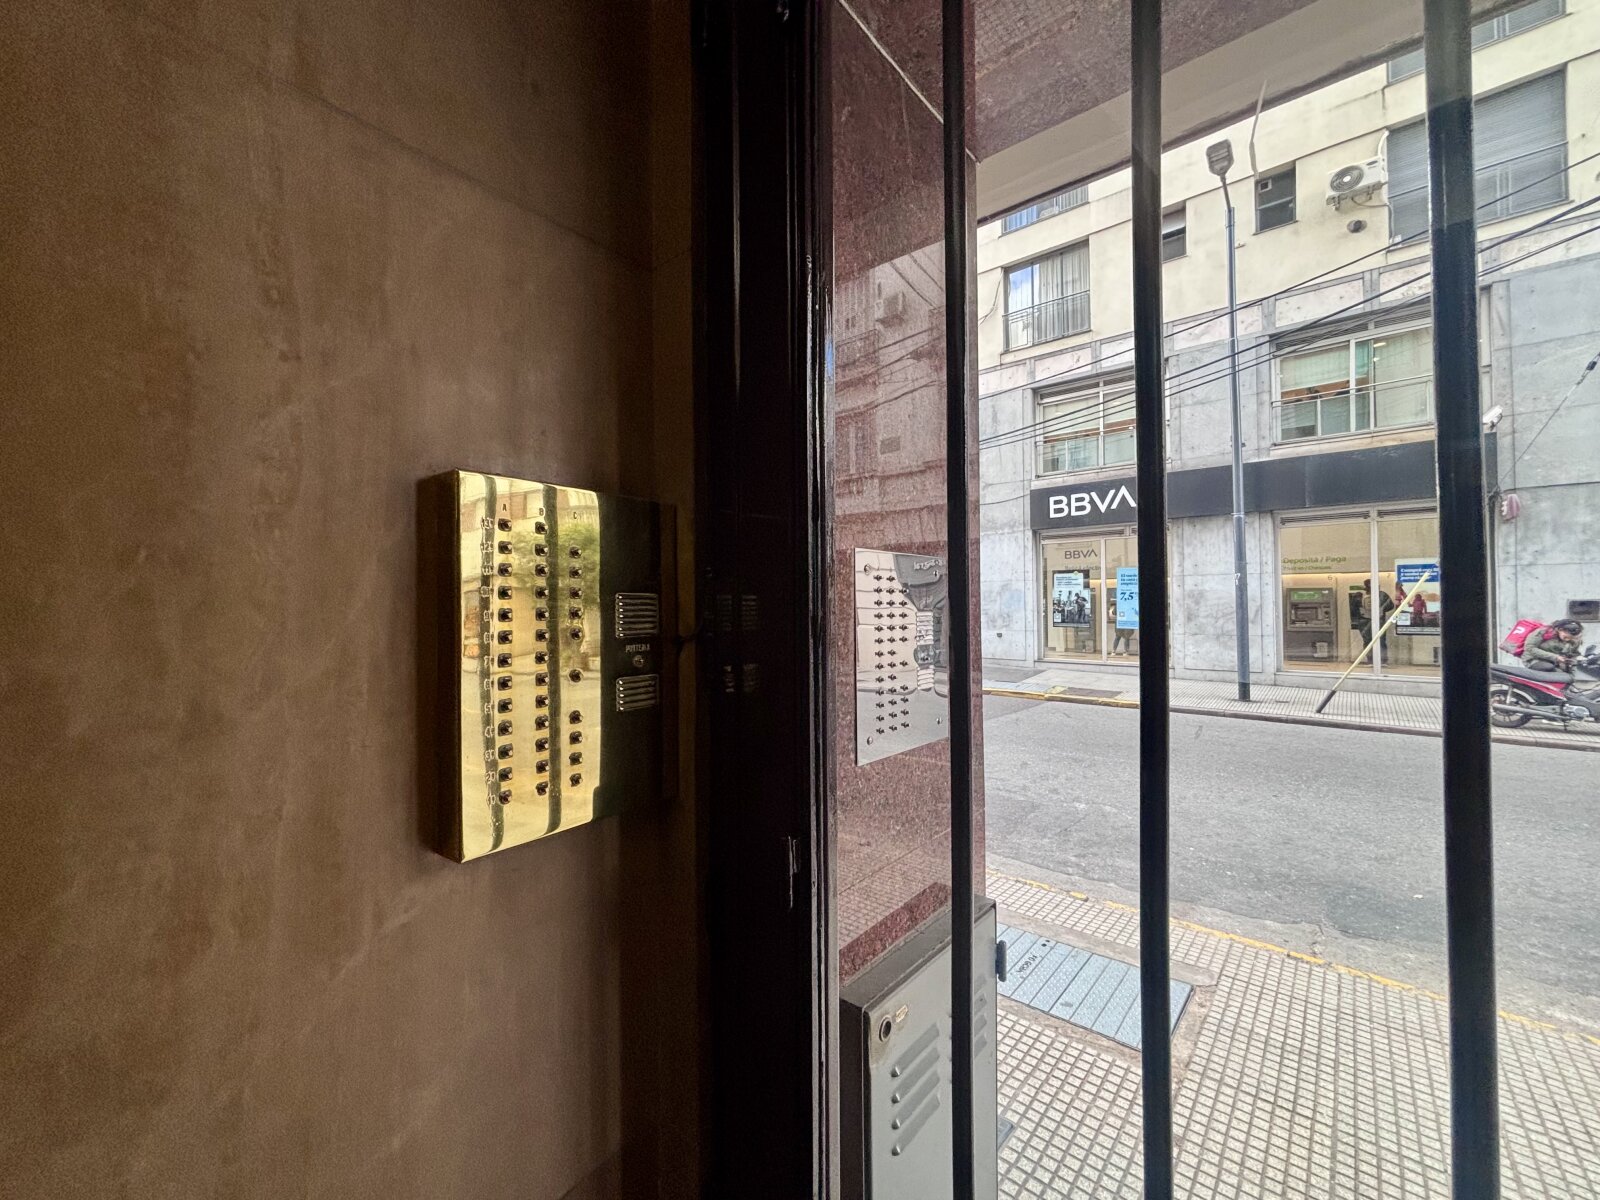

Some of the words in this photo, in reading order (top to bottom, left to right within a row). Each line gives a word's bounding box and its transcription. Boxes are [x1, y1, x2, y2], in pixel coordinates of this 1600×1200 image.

[1049, 485, 1137, 519] BBVA
[502, 503, 507, 512] A
[539, 507, 544, 516] B
[573, 511, 578, 520] C
[1064, 549, 1098, 560] BBVA
